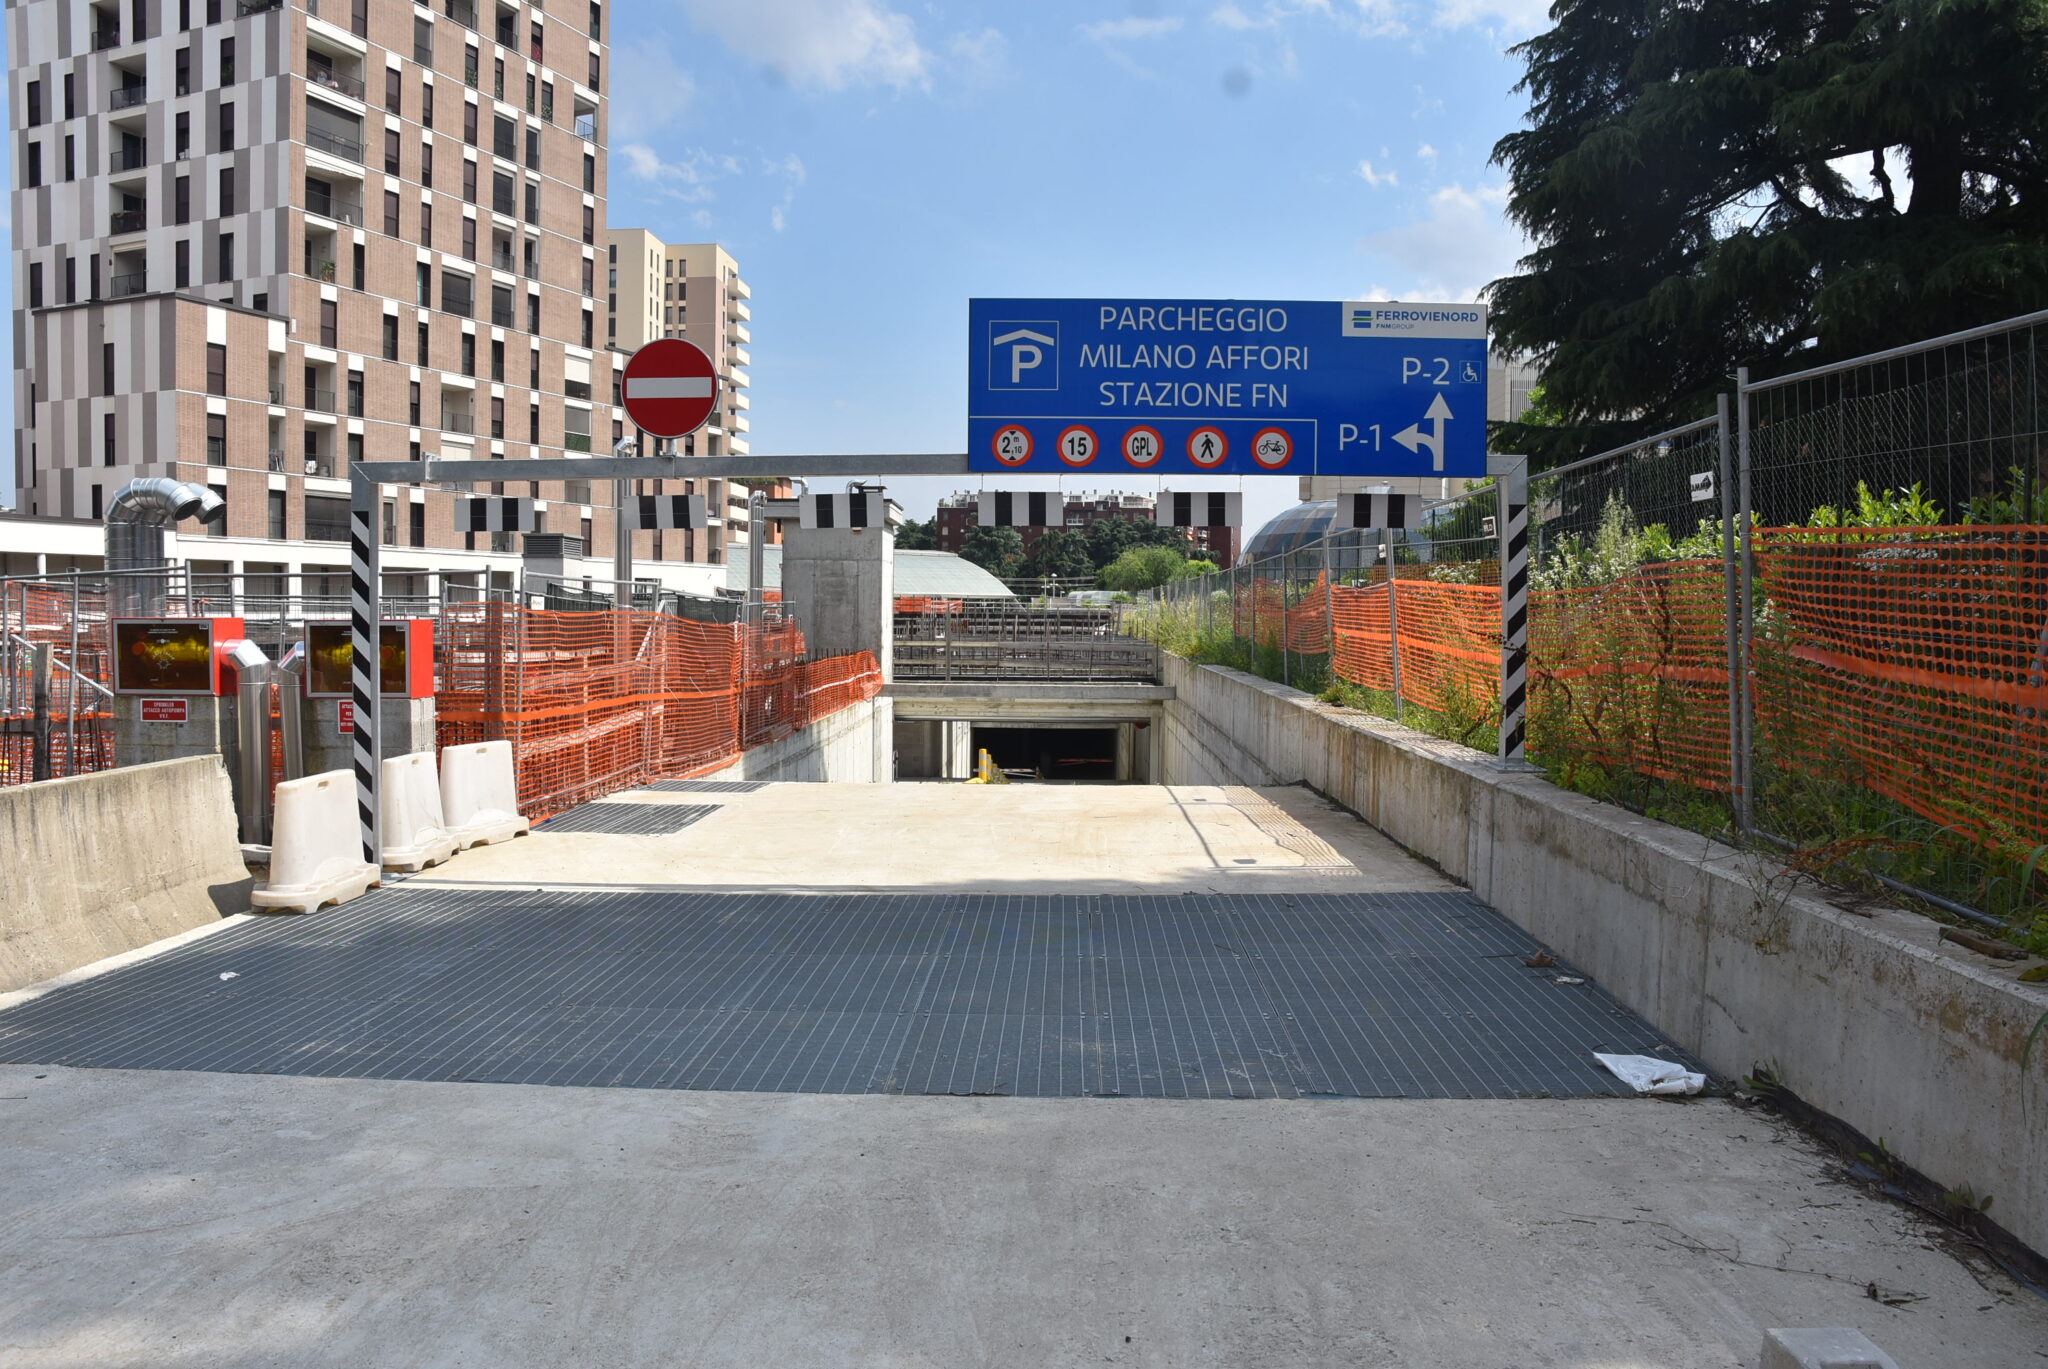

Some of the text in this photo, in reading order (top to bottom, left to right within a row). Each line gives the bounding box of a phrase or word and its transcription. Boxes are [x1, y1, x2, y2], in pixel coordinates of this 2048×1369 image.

[1100, 306, 1288, 332] PARCHEGGIO
[1376, 310, 1479, 322] FERROVIENORD
[1012, 344, 1043, 383] P
[1079, 343, 1308, 370] MILANO AFFORI
[1402, 357, 1450, 385] P-2
[1099, 381, 1288, 408] STAZIONE FN
[1068, 437, 1087, 456] 15
[1131, 437, 1153, 456] GPL
[1339, 423, 1380, 451] P-1
